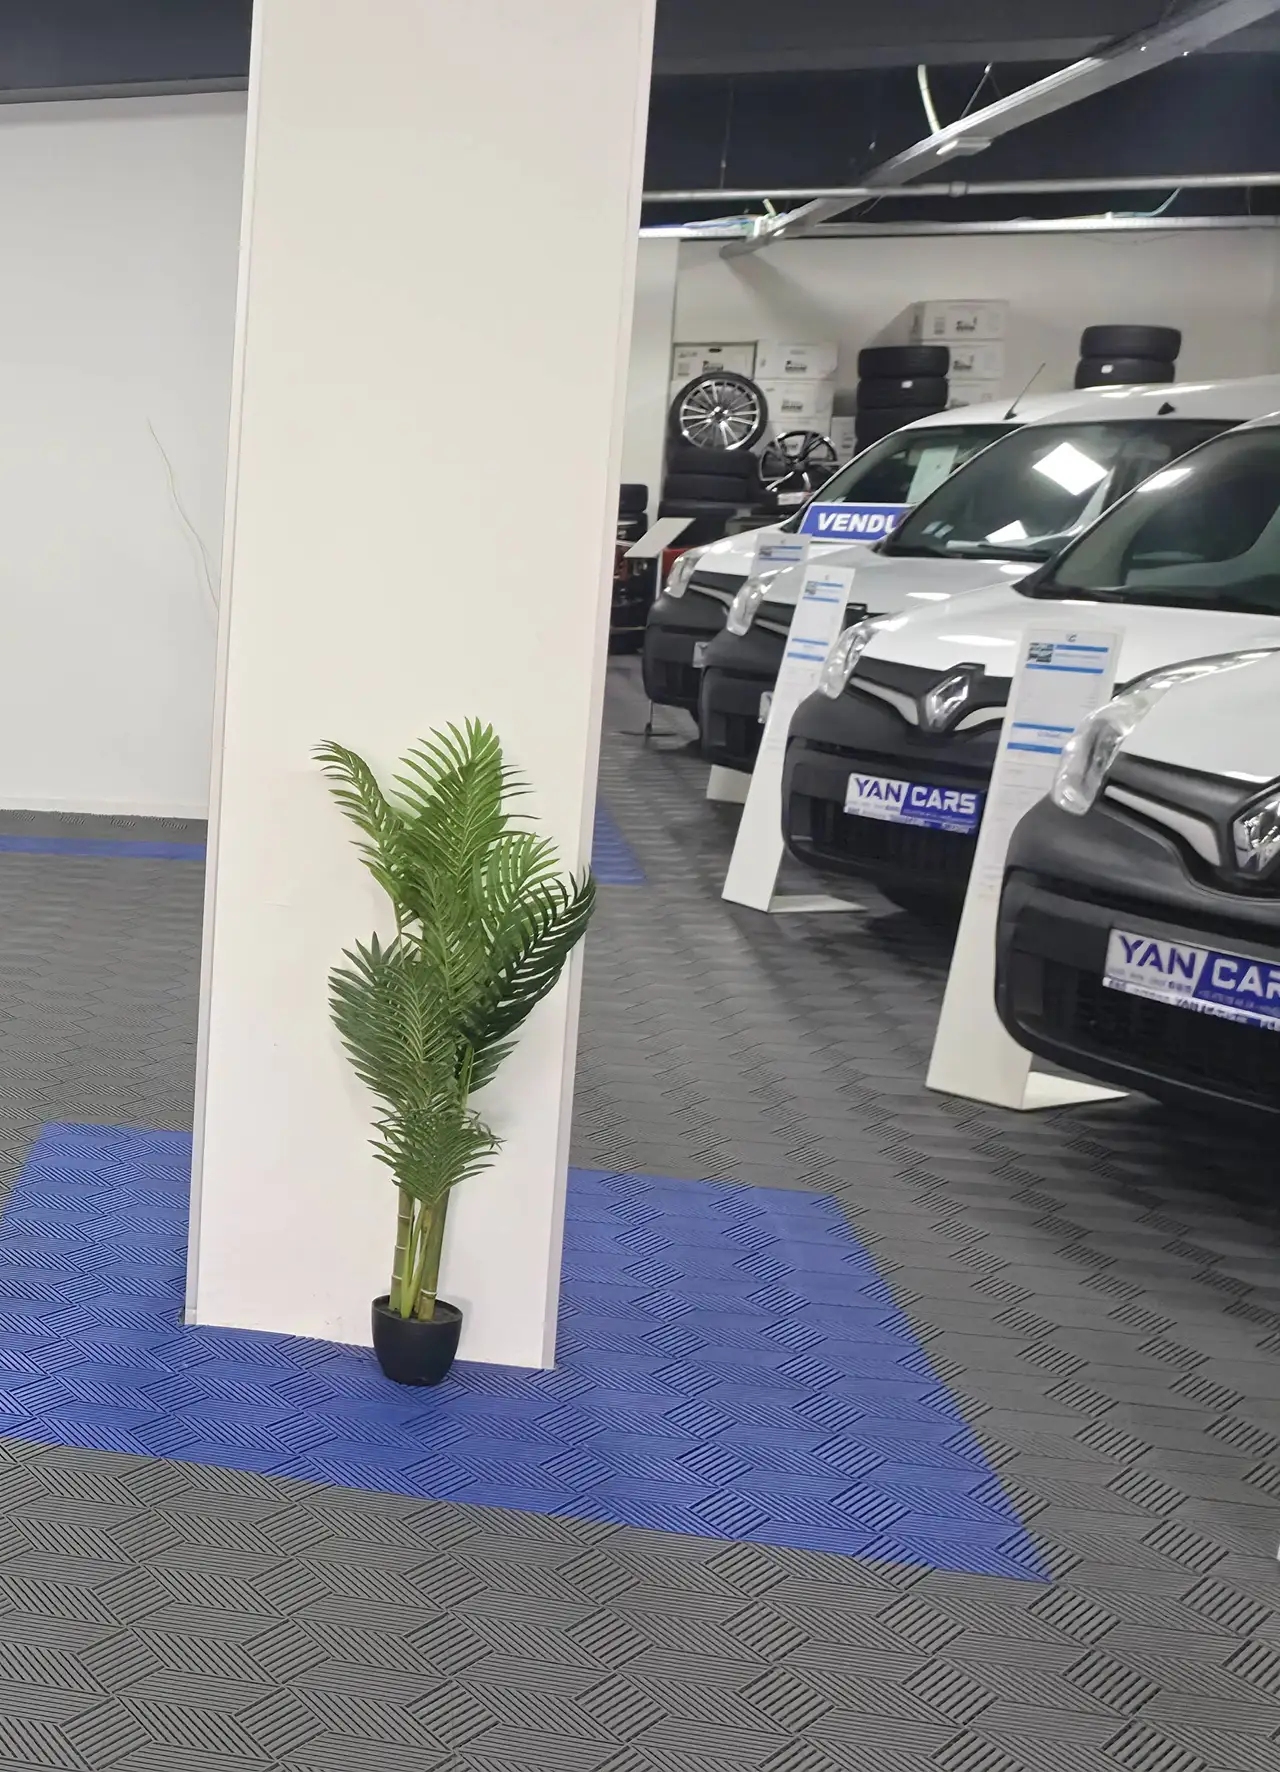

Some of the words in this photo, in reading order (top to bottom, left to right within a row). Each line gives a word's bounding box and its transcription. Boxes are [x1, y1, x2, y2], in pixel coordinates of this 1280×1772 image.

[855, 777, 903, 803] YAN
[911, 786, 977, 814] CARS
[1119, 934, 1197, 979] YAN
